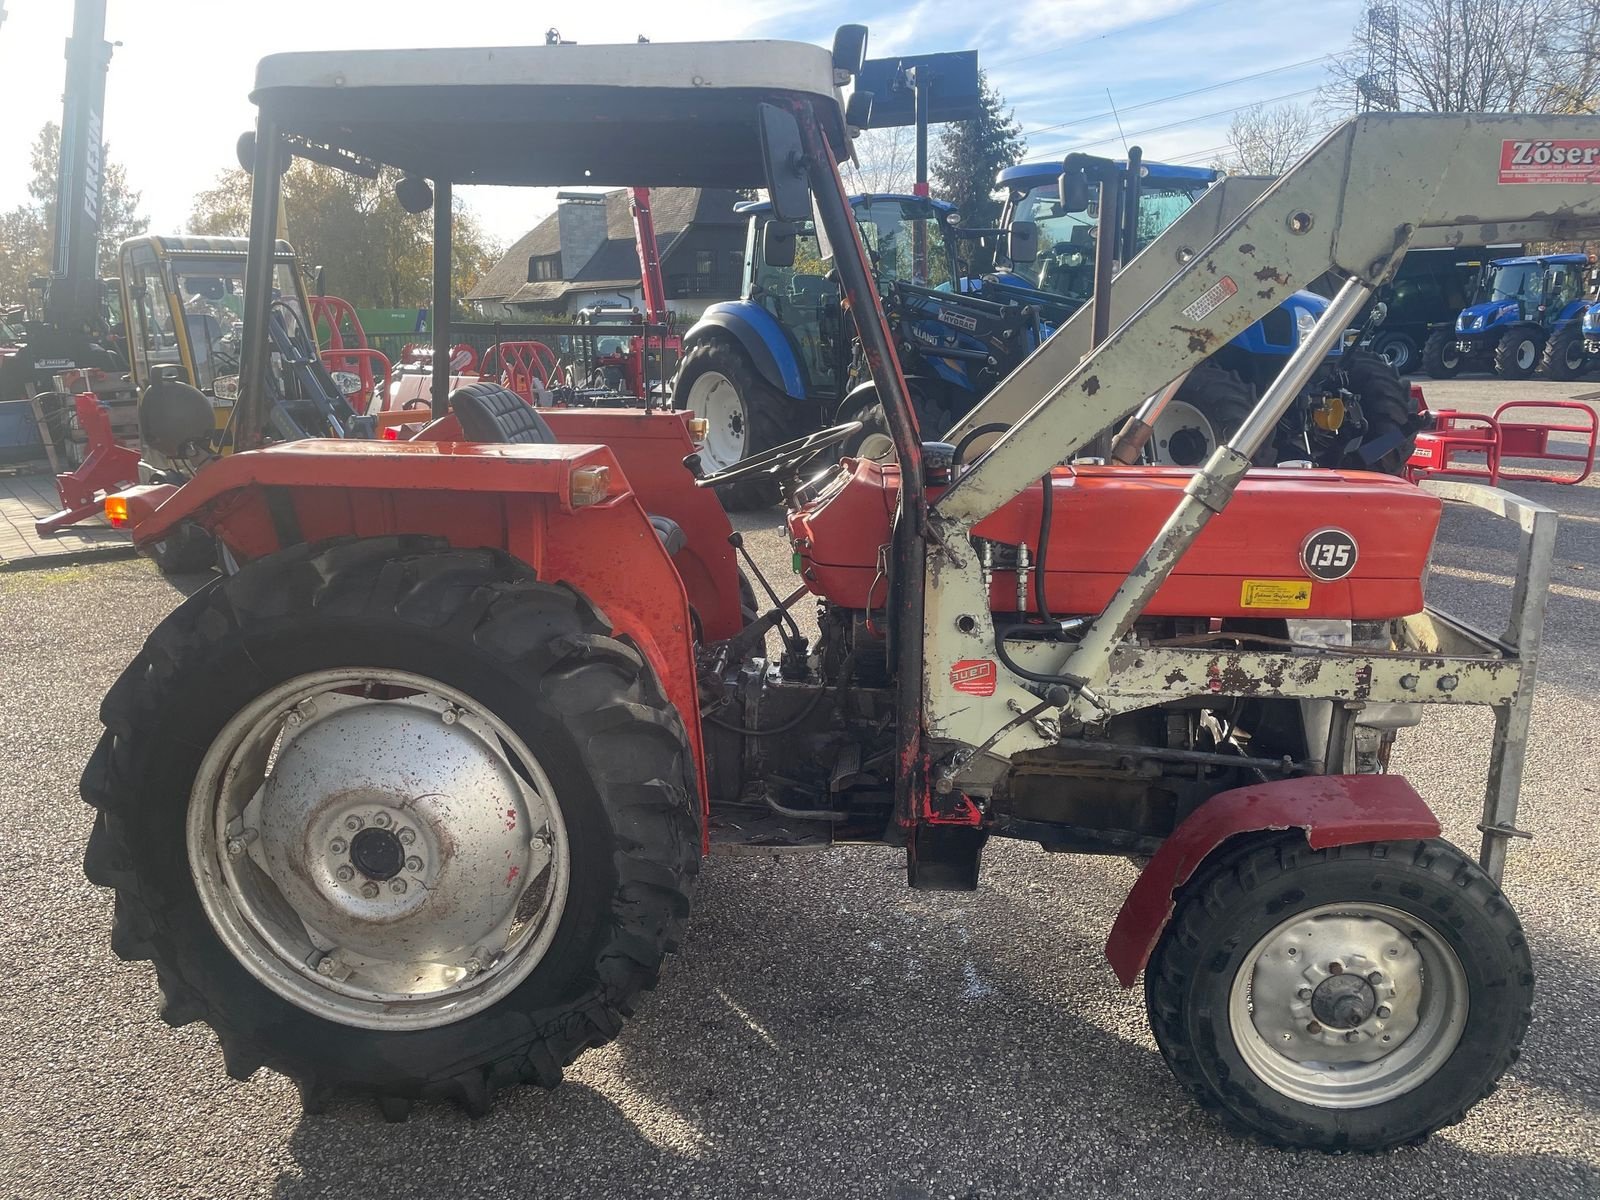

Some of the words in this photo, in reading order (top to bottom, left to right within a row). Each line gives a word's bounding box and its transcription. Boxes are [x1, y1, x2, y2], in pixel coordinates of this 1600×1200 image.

[1511, 141, 1600, 165] Zöser
[83, 107, 101, 222] FARESIN
[943, 314, 974, 331] HYDRAC
[1310, 544, 1352, 566] 135
[952, 666, 987, 680] auer
